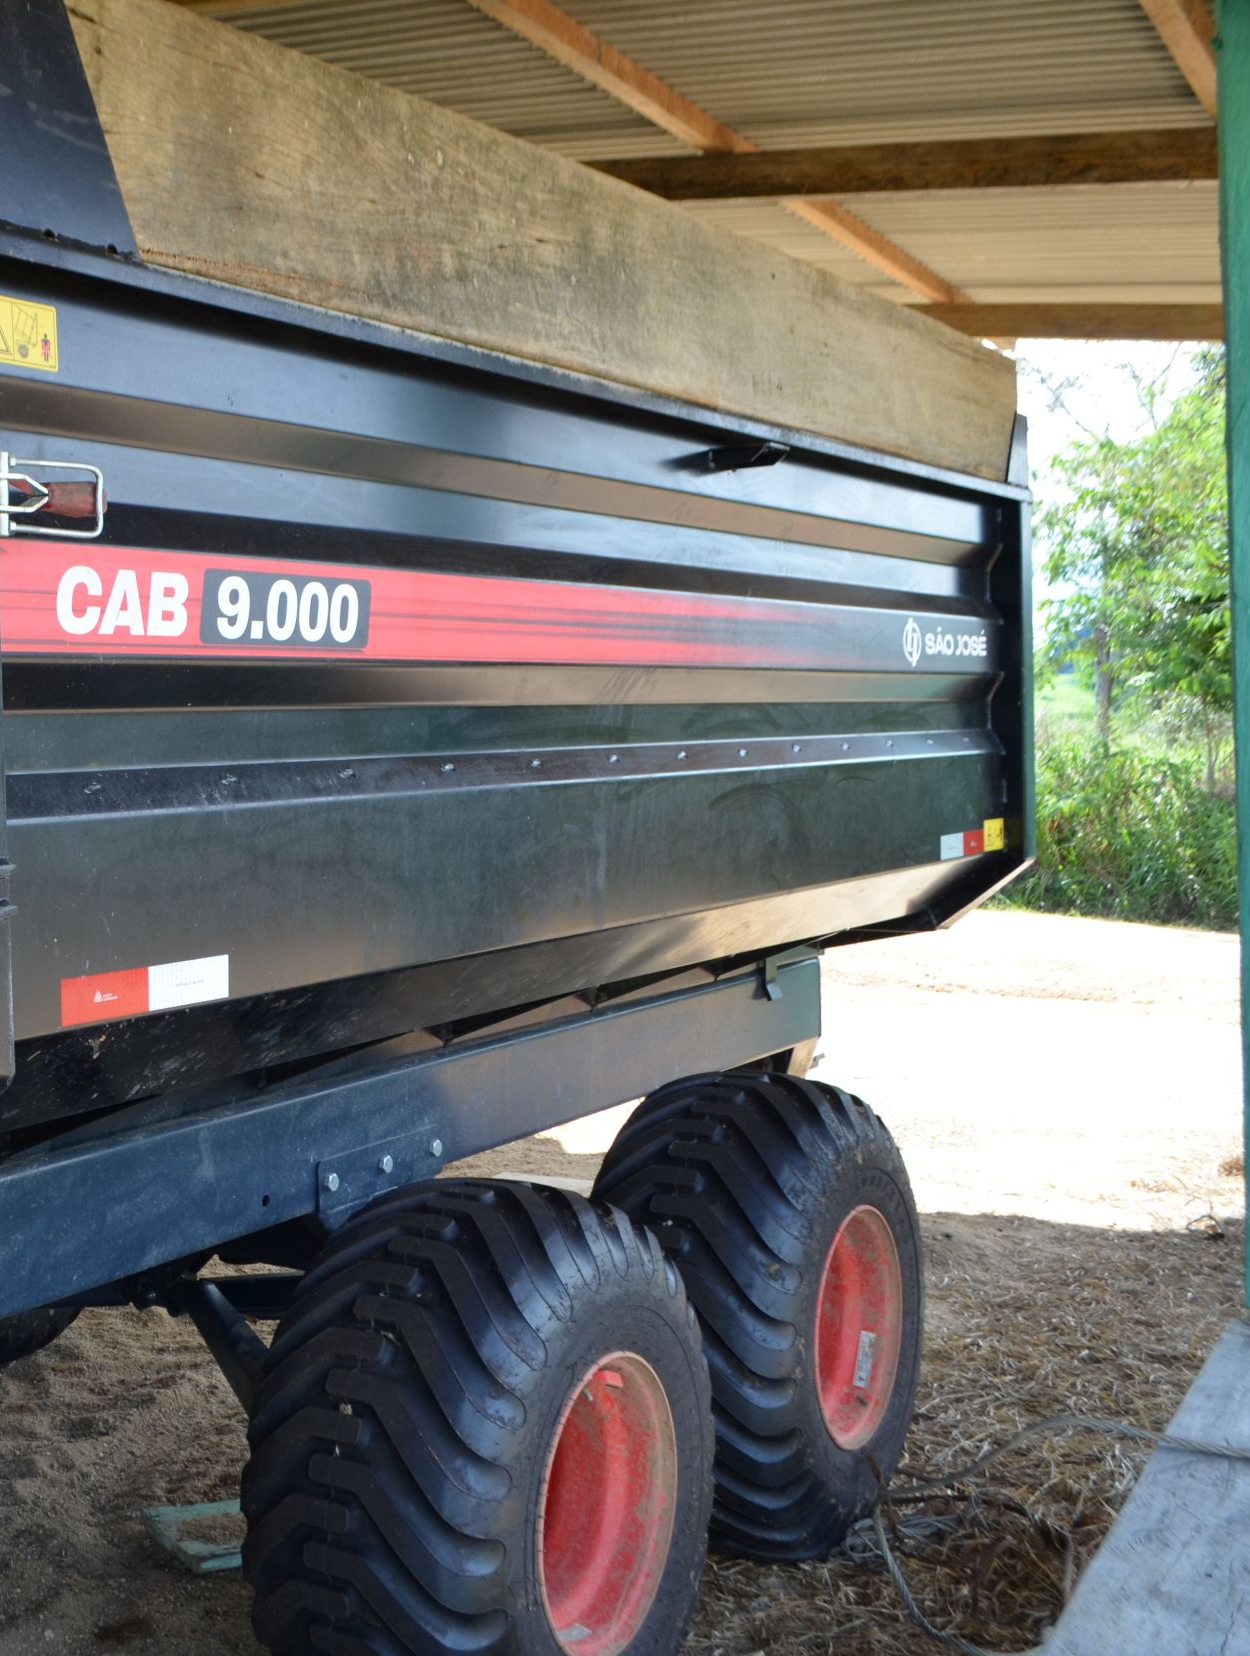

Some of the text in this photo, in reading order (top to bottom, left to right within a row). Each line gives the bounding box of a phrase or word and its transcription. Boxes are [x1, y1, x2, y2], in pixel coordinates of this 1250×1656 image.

[56, 565, 359, 643] CAB 9.000
[925, 626, 988, 657] SÃO JOSÉ
